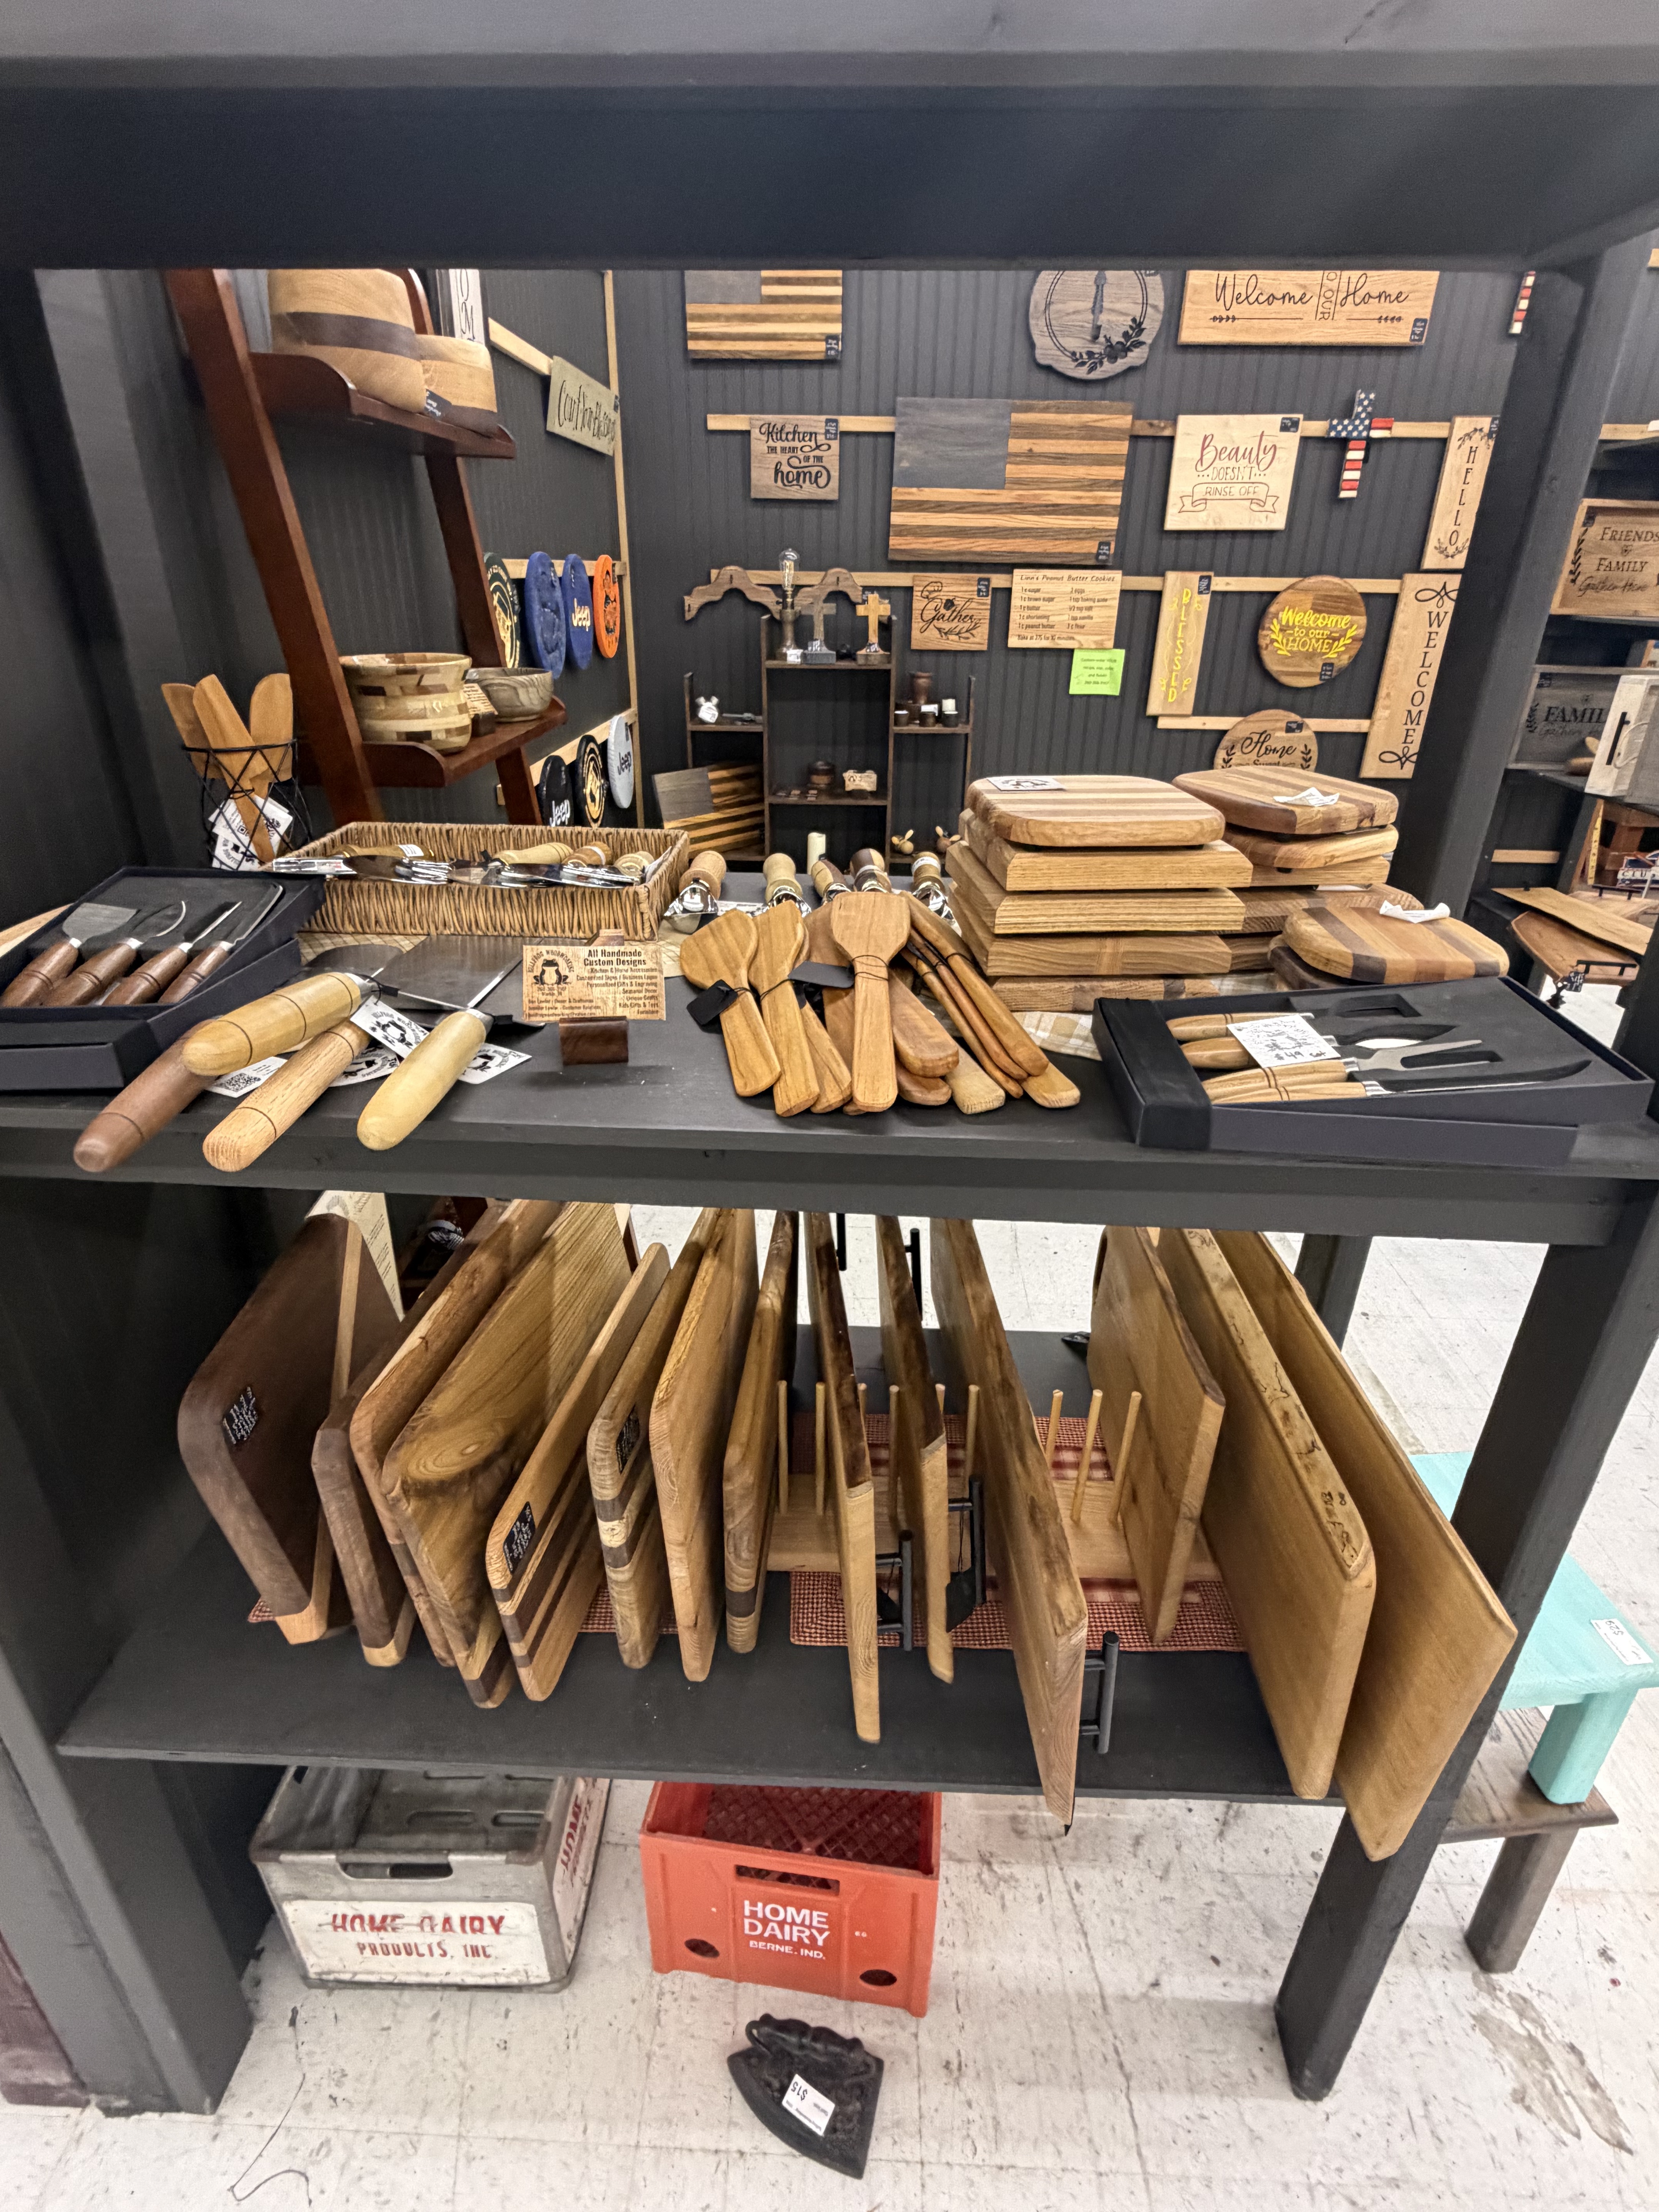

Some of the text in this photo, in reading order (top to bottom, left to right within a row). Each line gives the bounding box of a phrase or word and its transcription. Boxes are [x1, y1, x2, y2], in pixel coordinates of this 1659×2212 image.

[1215, 273, 1312, 311] Welcome
[1340, 273, 1409, 307] Home
[1319, 290, 1334, 320] OUR
[759, 422, 817, 447] Kitchen
[1195, 431, 1277, 472] Beauty
[775, 461, 831, 488] home
[1205, 486, 1259, 496] RINSE OFF
[1449, 446, 1478, 546] HELLO
[572, 598, 591, 631] Jeep
[920, 598, 976, 633] Gather
[1281, 606, 1351, 629] Welcome
[1168, 588, 1191, 702] BLESSED
[1287, 637, 1332, 653] HOME
[1294, 626, 1330, 638] to our
[1402, 611, 1449, 744] WELCOME
[1543, 706, 1607, 723] FAMIL
[1241, 730, 1297, 759] Home
[550, 800, 570, 827] Jeep
[588, 949, 642, 957] All Handmade
[617, 958, 646, 967] Designs
[744, 1900, 829, 1929] HOME
[744, 1918, 830, 1946] DAIRY
[791, 2081, 808, 2101] $15
